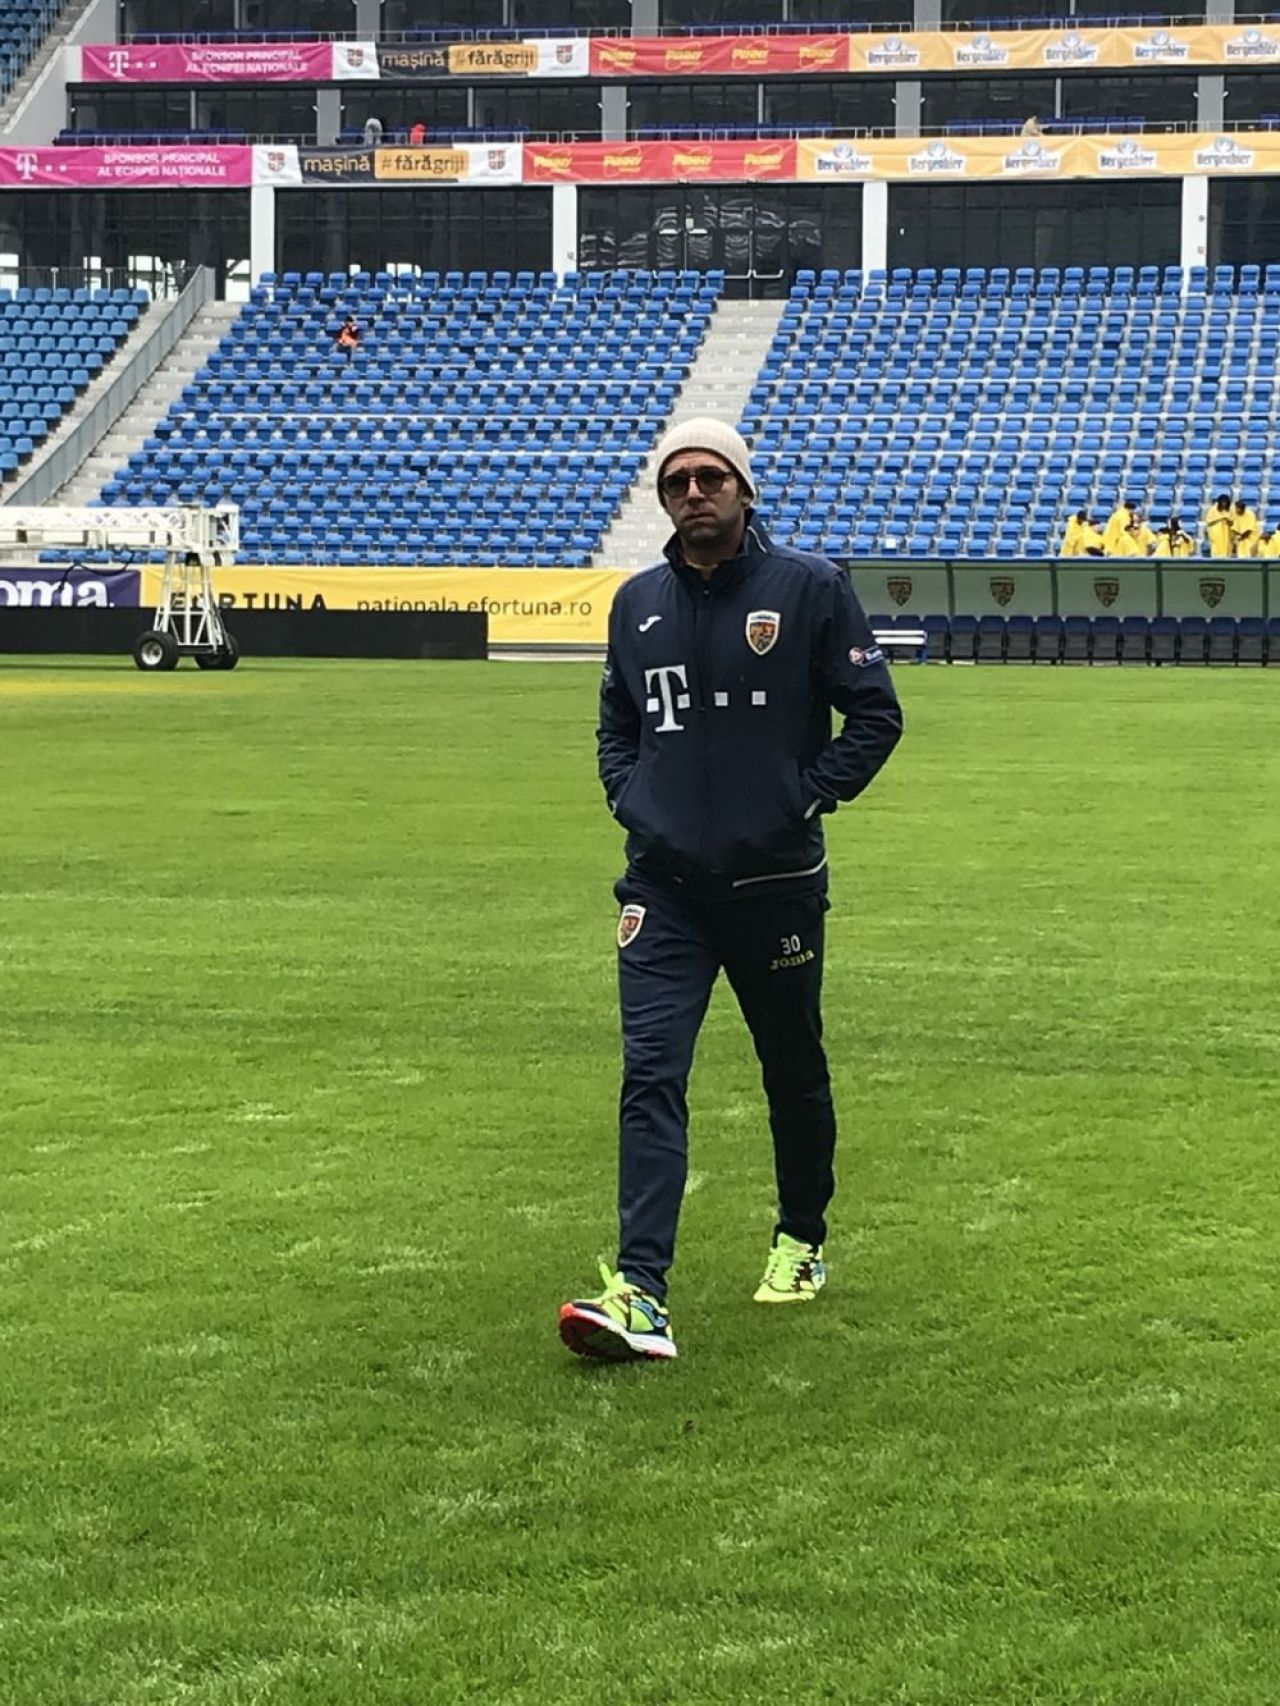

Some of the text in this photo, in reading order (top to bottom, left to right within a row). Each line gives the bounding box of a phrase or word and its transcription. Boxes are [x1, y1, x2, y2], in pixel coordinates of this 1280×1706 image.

[104, 152, 220, 164] SPONSOR PRINCIPAL
[97, 165, 112, 176] AL
[644, 663, 691, 733] T
[780, 934, 801, 955] 30
